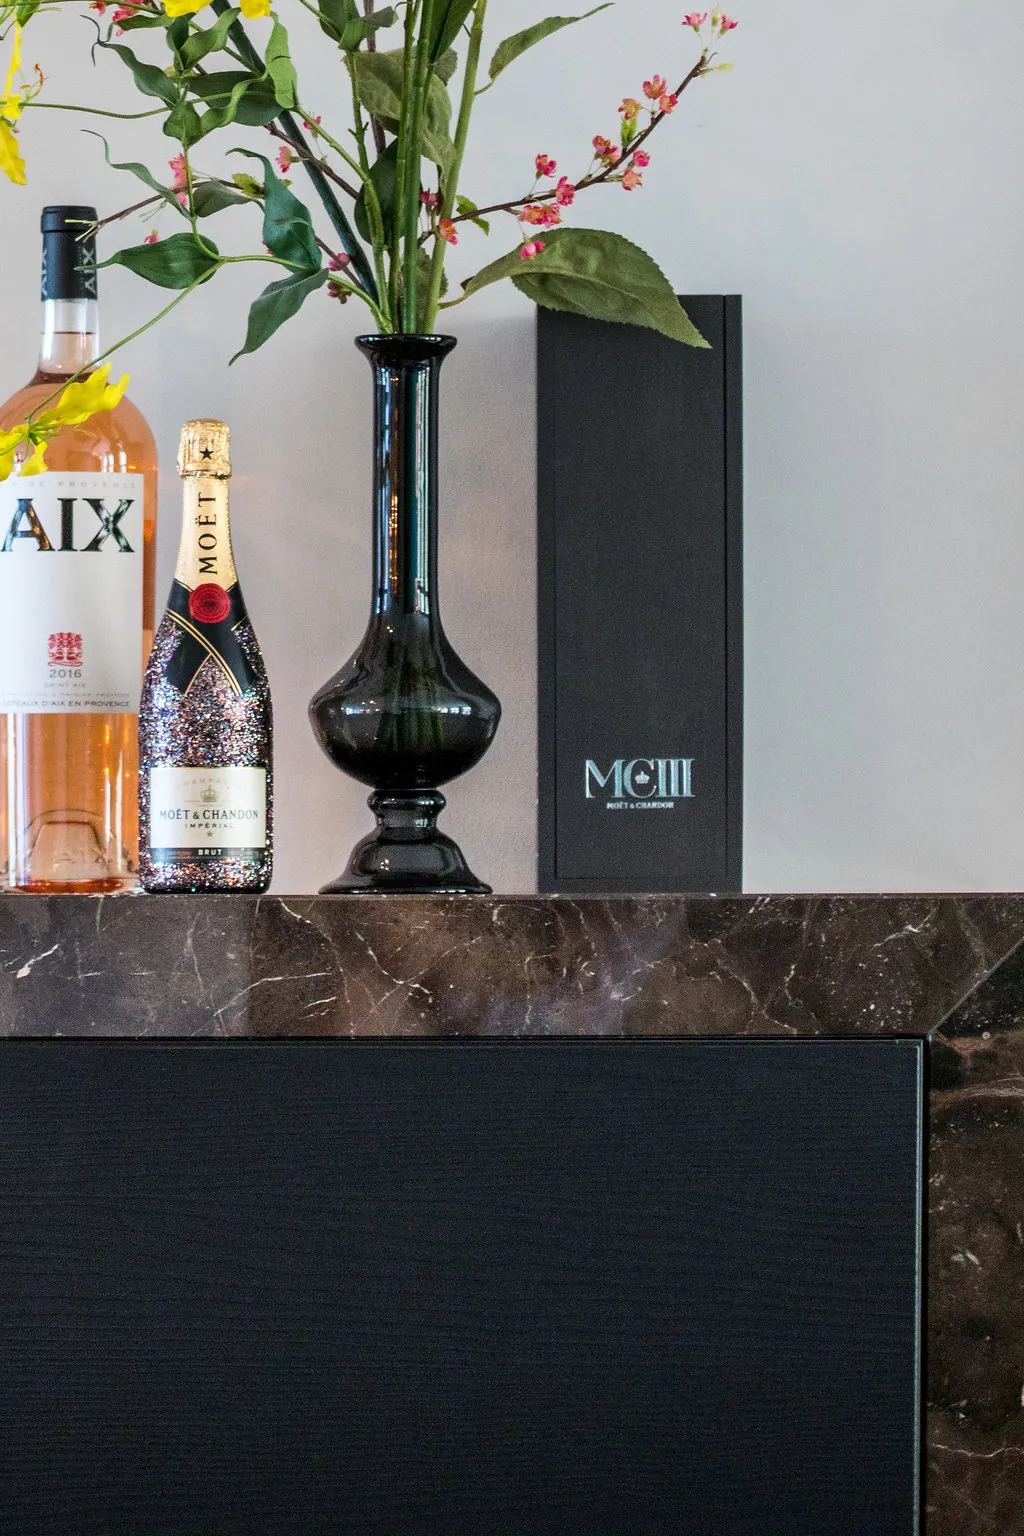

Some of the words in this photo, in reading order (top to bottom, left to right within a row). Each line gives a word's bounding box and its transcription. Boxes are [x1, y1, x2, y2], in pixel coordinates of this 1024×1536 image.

[1, 498, 135, 553] AIX
[195, 492, 218, 575] MOËT
[49, 668, 83, 678] 2016
[68, 699, 81, 707] EN
[84, 699, 130, 708] PROVENCE
[585, 757, 696, 799] MCIII
[636, 801, 674, 809] CHANDON
[192, 811, 200, 820] &
[202, 809, 260, 820] CHANDON
[184, 821, 235, 829] IMPÉRIAL
[197, 848, 223, 856] BRUT
